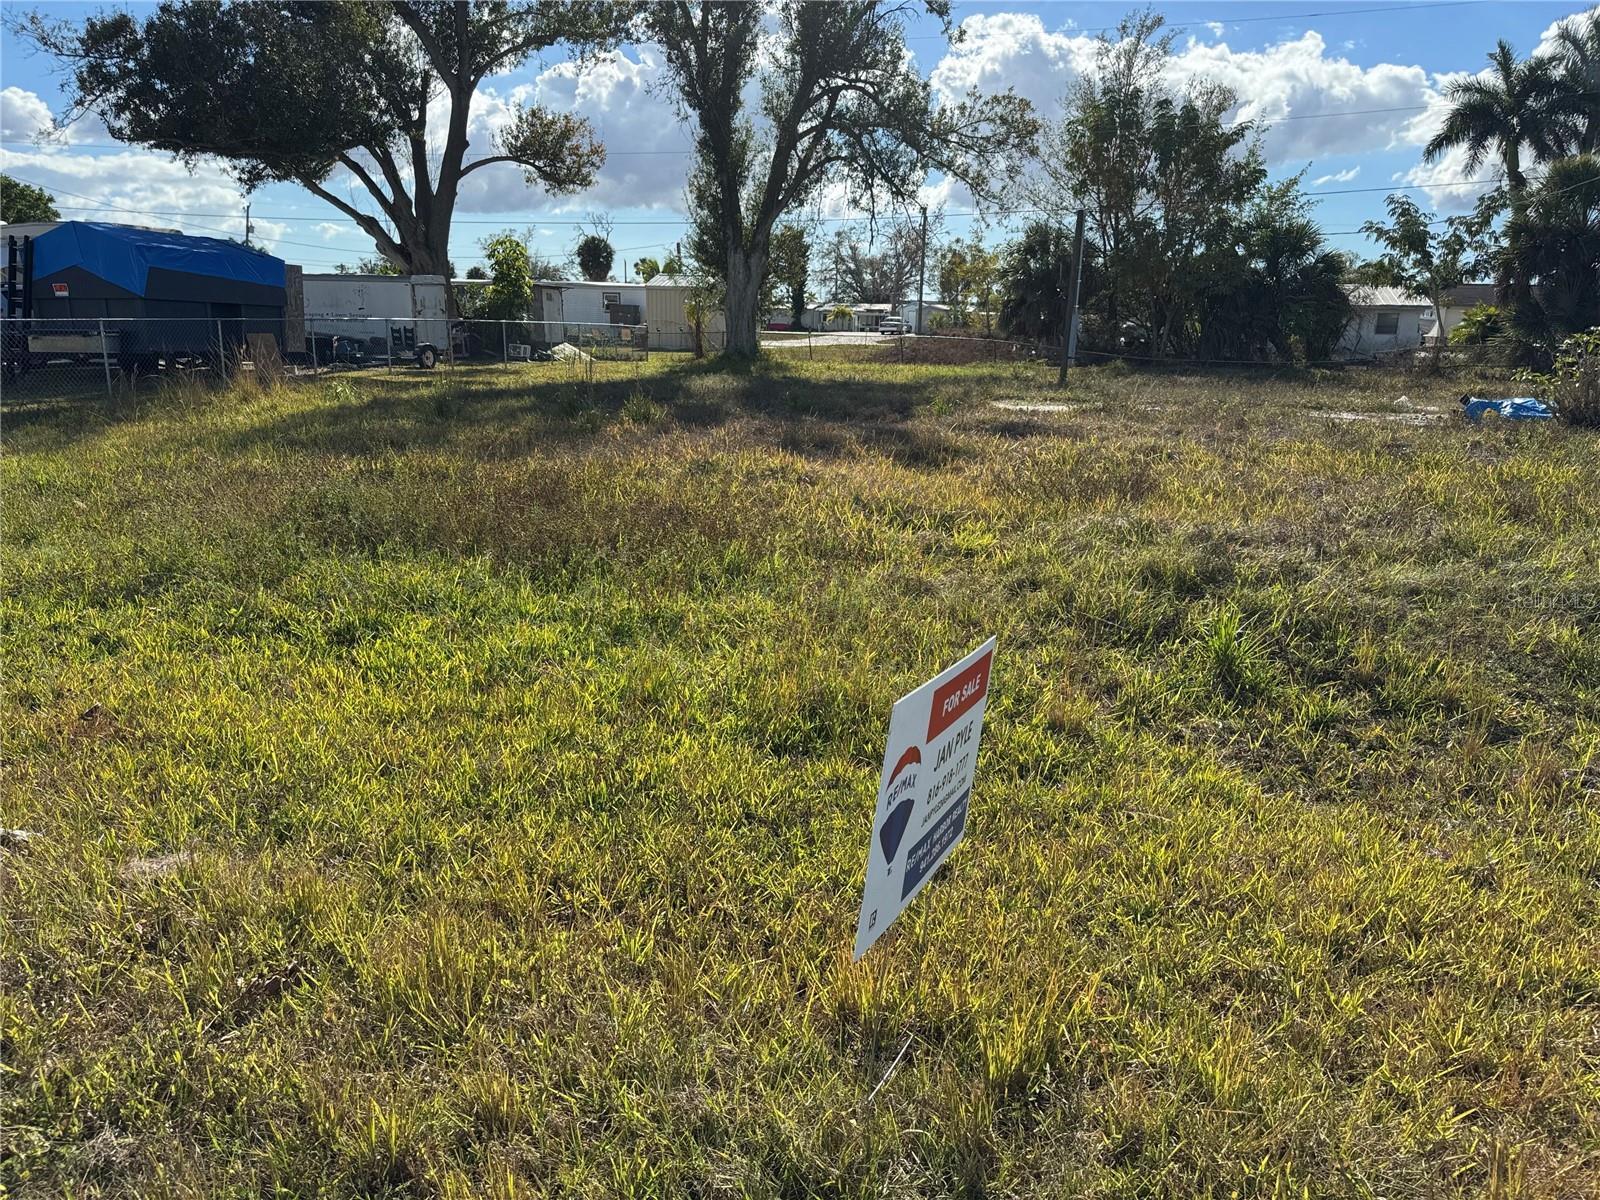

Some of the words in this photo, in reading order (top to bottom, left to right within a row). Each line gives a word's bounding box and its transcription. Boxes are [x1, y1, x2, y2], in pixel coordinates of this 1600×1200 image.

[942, 690, 961, 717] FOR
[961, 673, 981, 702] SALE
[933, 737, 955, 772] JAN
[954, 720, 974, 754] PYLE
[886, 774, 917, 811] RE/MAX
[906, 838, 931, 873] RE/MAX
